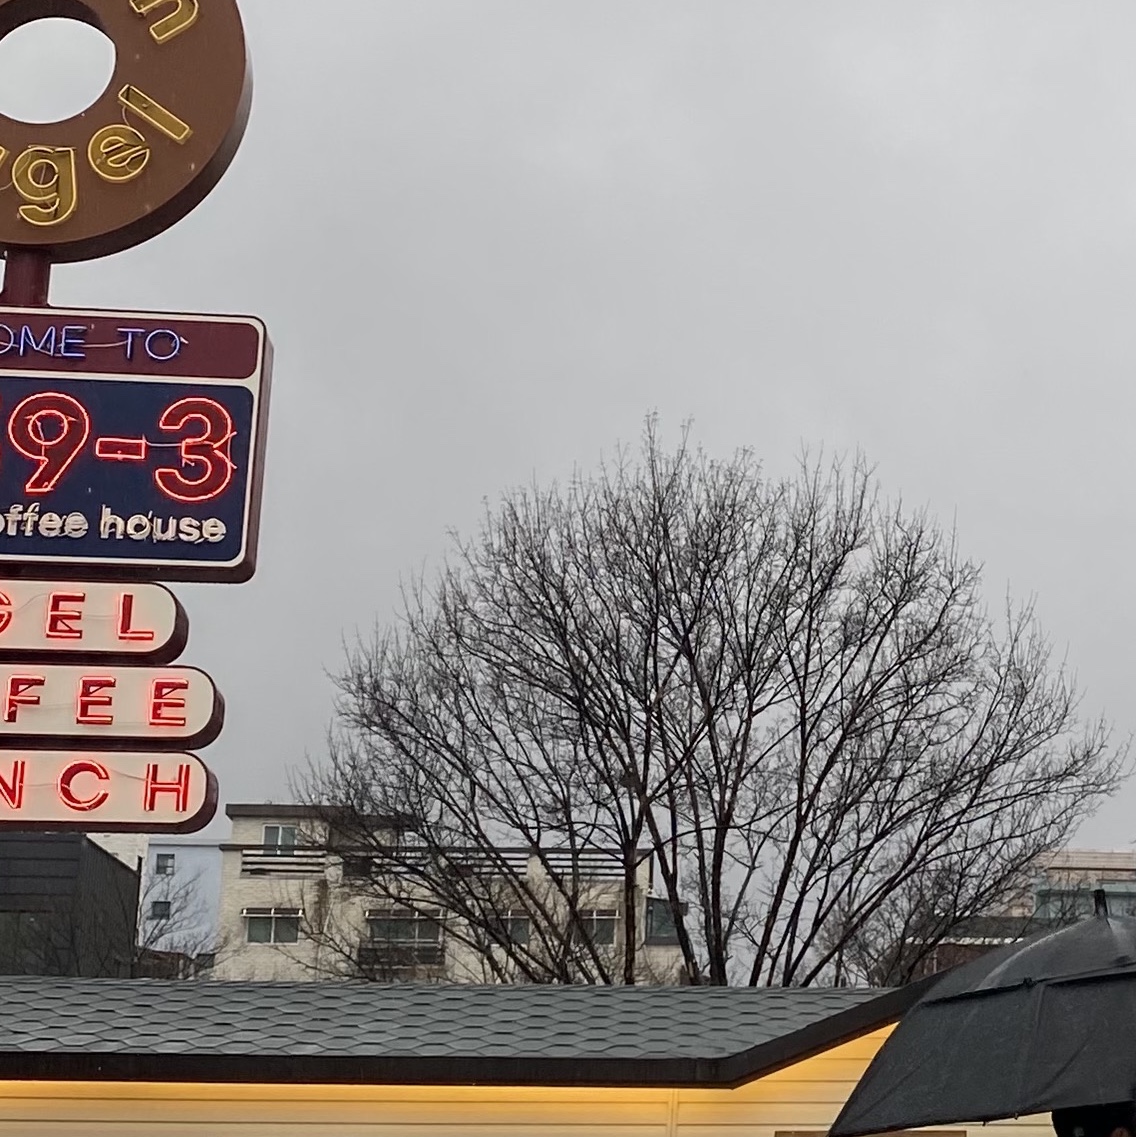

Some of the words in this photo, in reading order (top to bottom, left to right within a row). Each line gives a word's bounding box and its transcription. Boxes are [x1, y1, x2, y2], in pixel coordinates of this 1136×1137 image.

[117, 327, 181, 360] TO
[0, 502, 89, 538] ffee
[99, 504, 227, 543] house
[0, 590, 155, 641] EL
[4, 673, 190, 727] FEE
